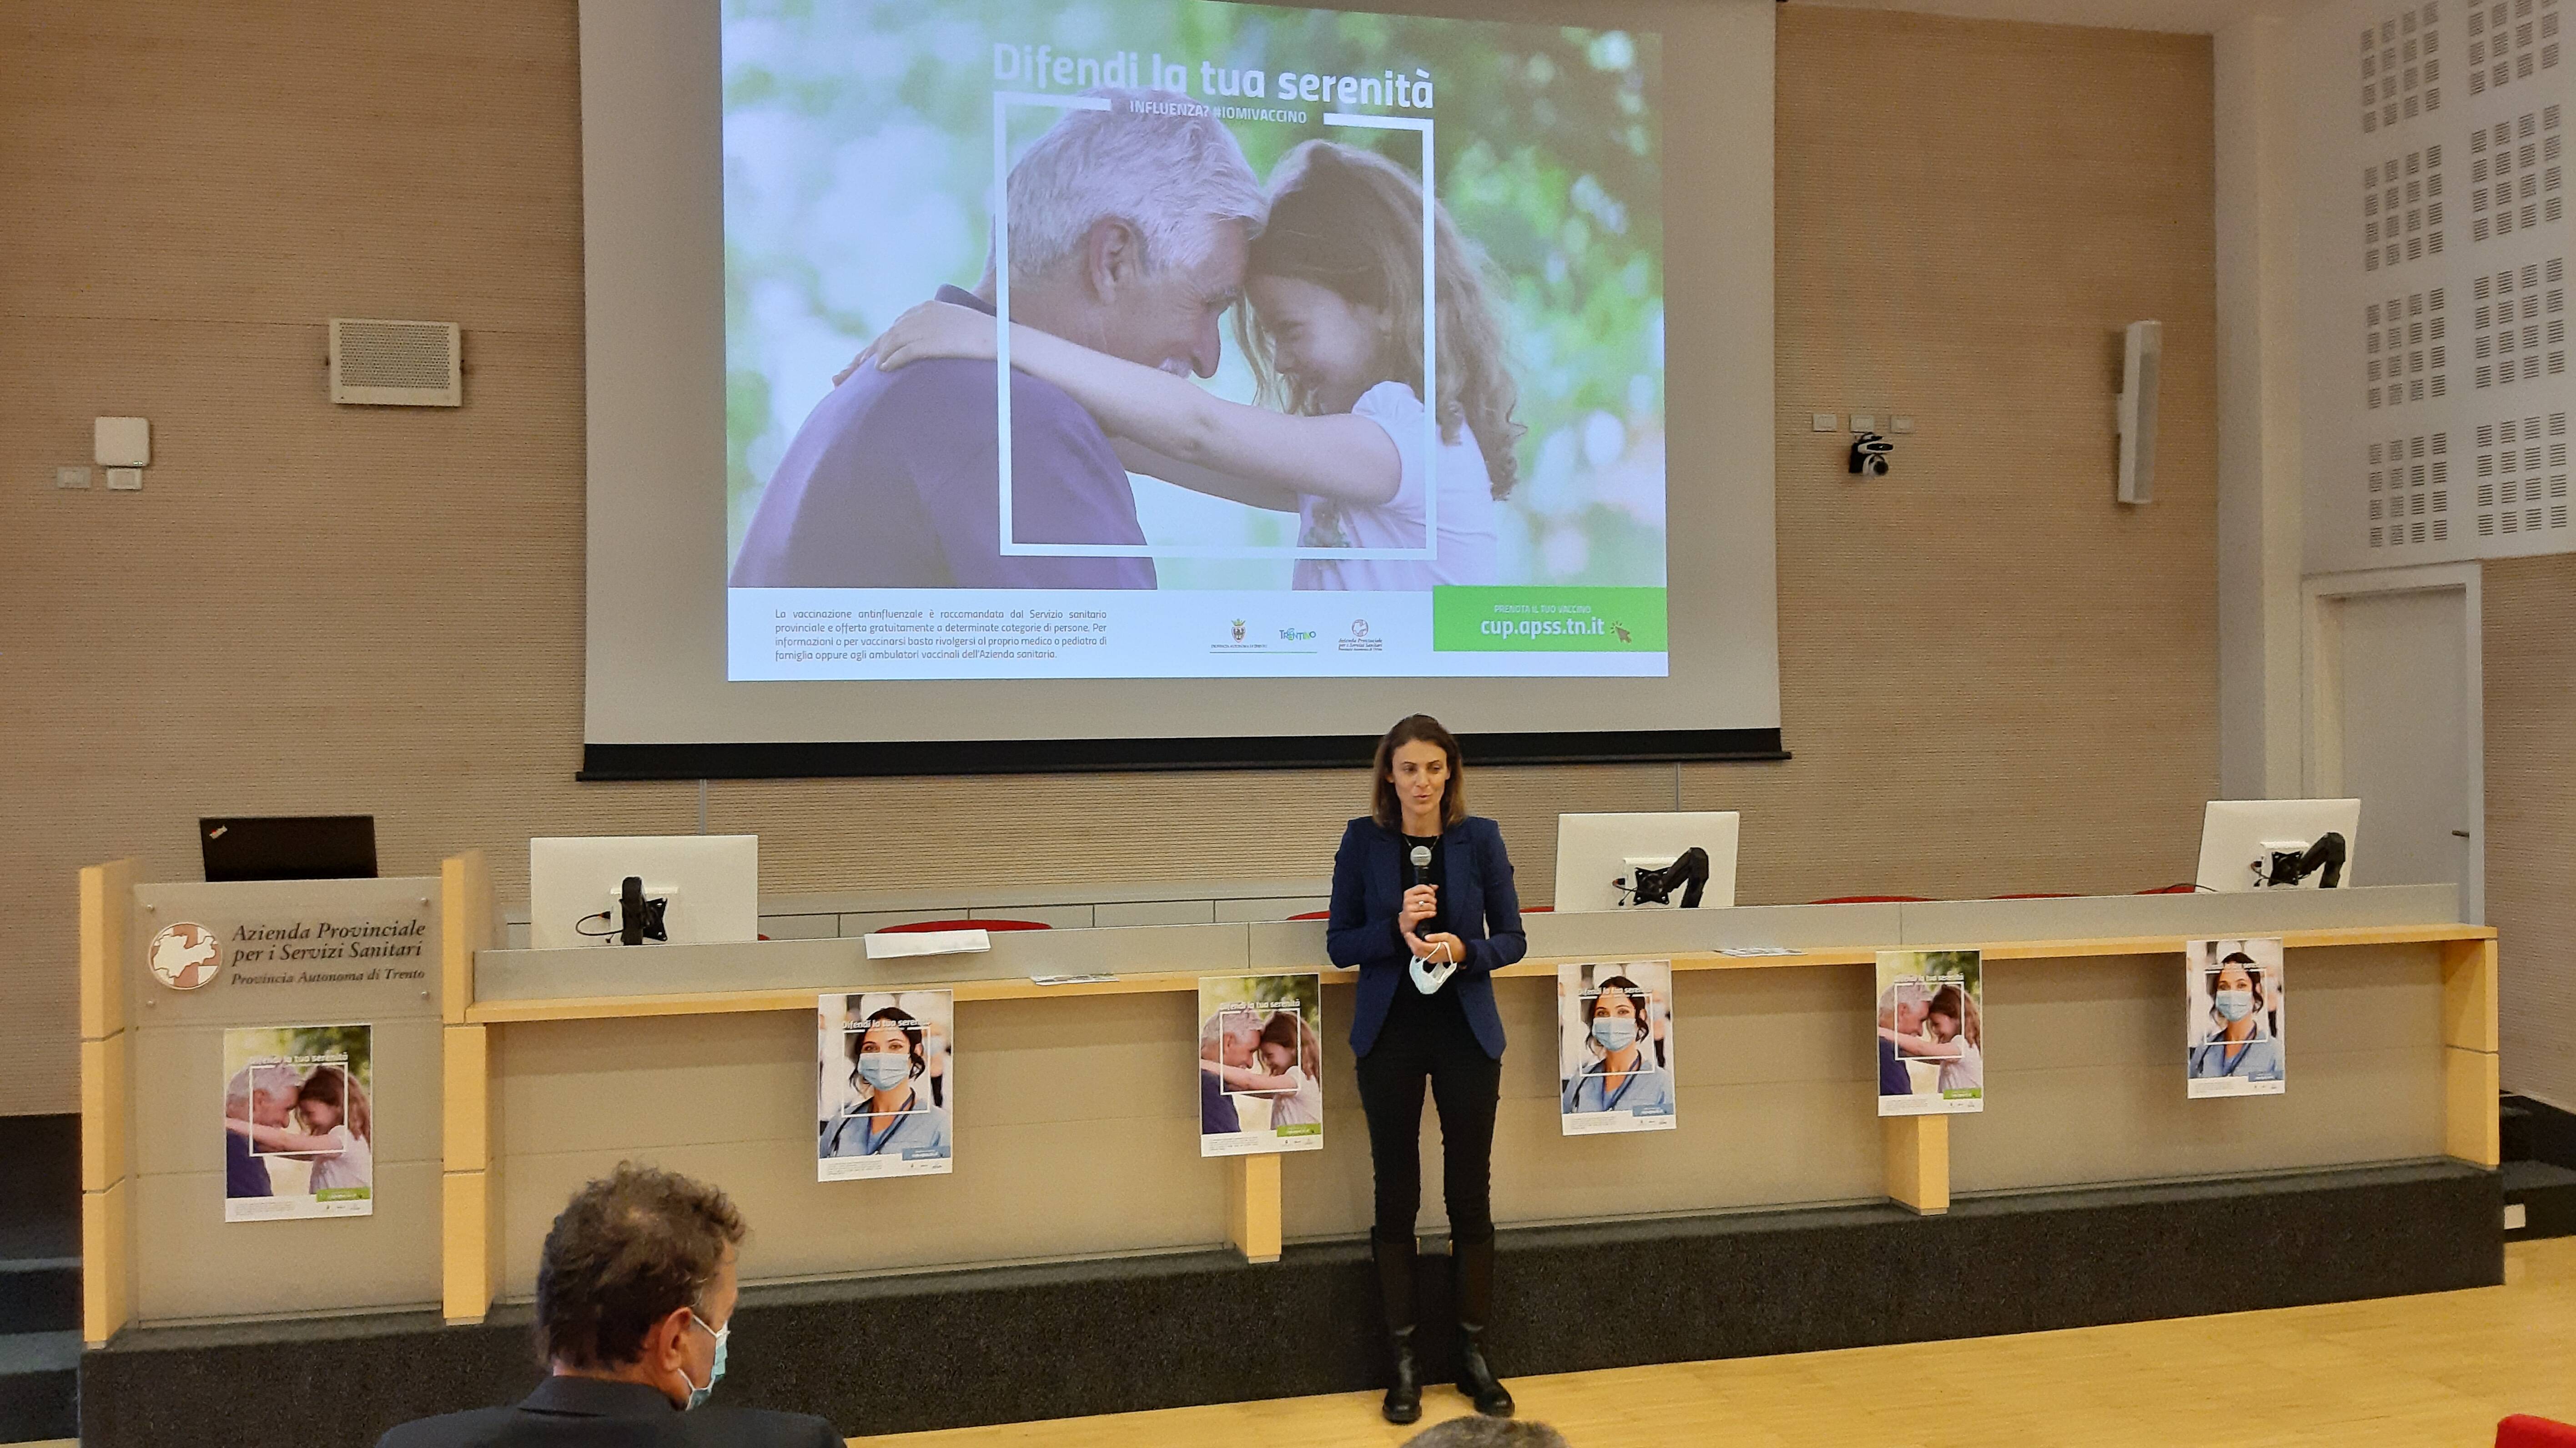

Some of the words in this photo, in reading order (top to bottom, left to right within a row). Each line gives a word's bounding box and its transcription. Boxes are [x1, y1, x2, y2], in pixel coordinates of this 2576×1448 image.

[994, 43, 1137, 89] Difendi
[1152, 53, 1187, 92] la
[1201, 61, 1265, 98] tua
[1278, 68, 1434, 109] serenità
[1130, 100, 1210, 117] INFLUENZA?
[1213, 106, 1307, 124] #IOMIVACCINO
[775, 609, 786, 618] La
[793, 610, 851, 618] vaccinazione
[859, 609, 923, 620] antinfluenzale
[929, 610, 934, 618] è
[941, 610, 1004, 618] raccomandata
[1010, 610, 1023, 618] dal
[1030, 610, 1063, 618] Servizio
[1069, 610, 1107, 618] sanitario
[775, 623, 825, 634] provinciale
[835, 623, 867, 634] offerta
[870, 623, 934, 634] gratuitamente
[946, 623, 999, 632] determinate
[1001, 623, 1041, 634] categorie
[1044, 623, 1052, 632] di
[1054, 625, 1090, 634] persone.
[1093, 623, 1107, 632] Per
[1480, 617, 1605, 640] cup.apss.tn.it
[775, 637, 833, 648] informazioni
[844, 639, 858, 647] per
[861, 637, 906, 646] vaccinarsi
[908, 637, 933, 645] basta
[936, 637, 975, 647] rivolgersi
[978, 637, 986, 645] al
[988, 637, 1019, 647] proprio
[1021, 637, 1052, 645] medico
[1062, 637, 1097, 647] pediatra
[1100, 637, 1107, 645] di
[775, 650, 813, 661] famiglia
[815, 652, 847, 661] oppure
[850, 650, 866, 661] agli
[869, 650, 919, 659] ambulatori
[922, 650, 959, 659] vaccinali
[962, 649, 1014, 659] dell'Azienda
[1017, 650, 1057, 659] sanitaria.
[232, 922, 311, 941] Azienda
[317, 919, 426, 938] Provinciale
[231, 949, 264, 967] per
[269, 945, 275, 960] i
[281, 943, 344, 960] Servizi
[349, 940, 422, 958] Sanitari
[231, 972, 294, 985] Provincia
[298, 971, 363, 983] Autonoma
[367, 968, 380, 980] di
[384, 968, 425, 980] Trento
